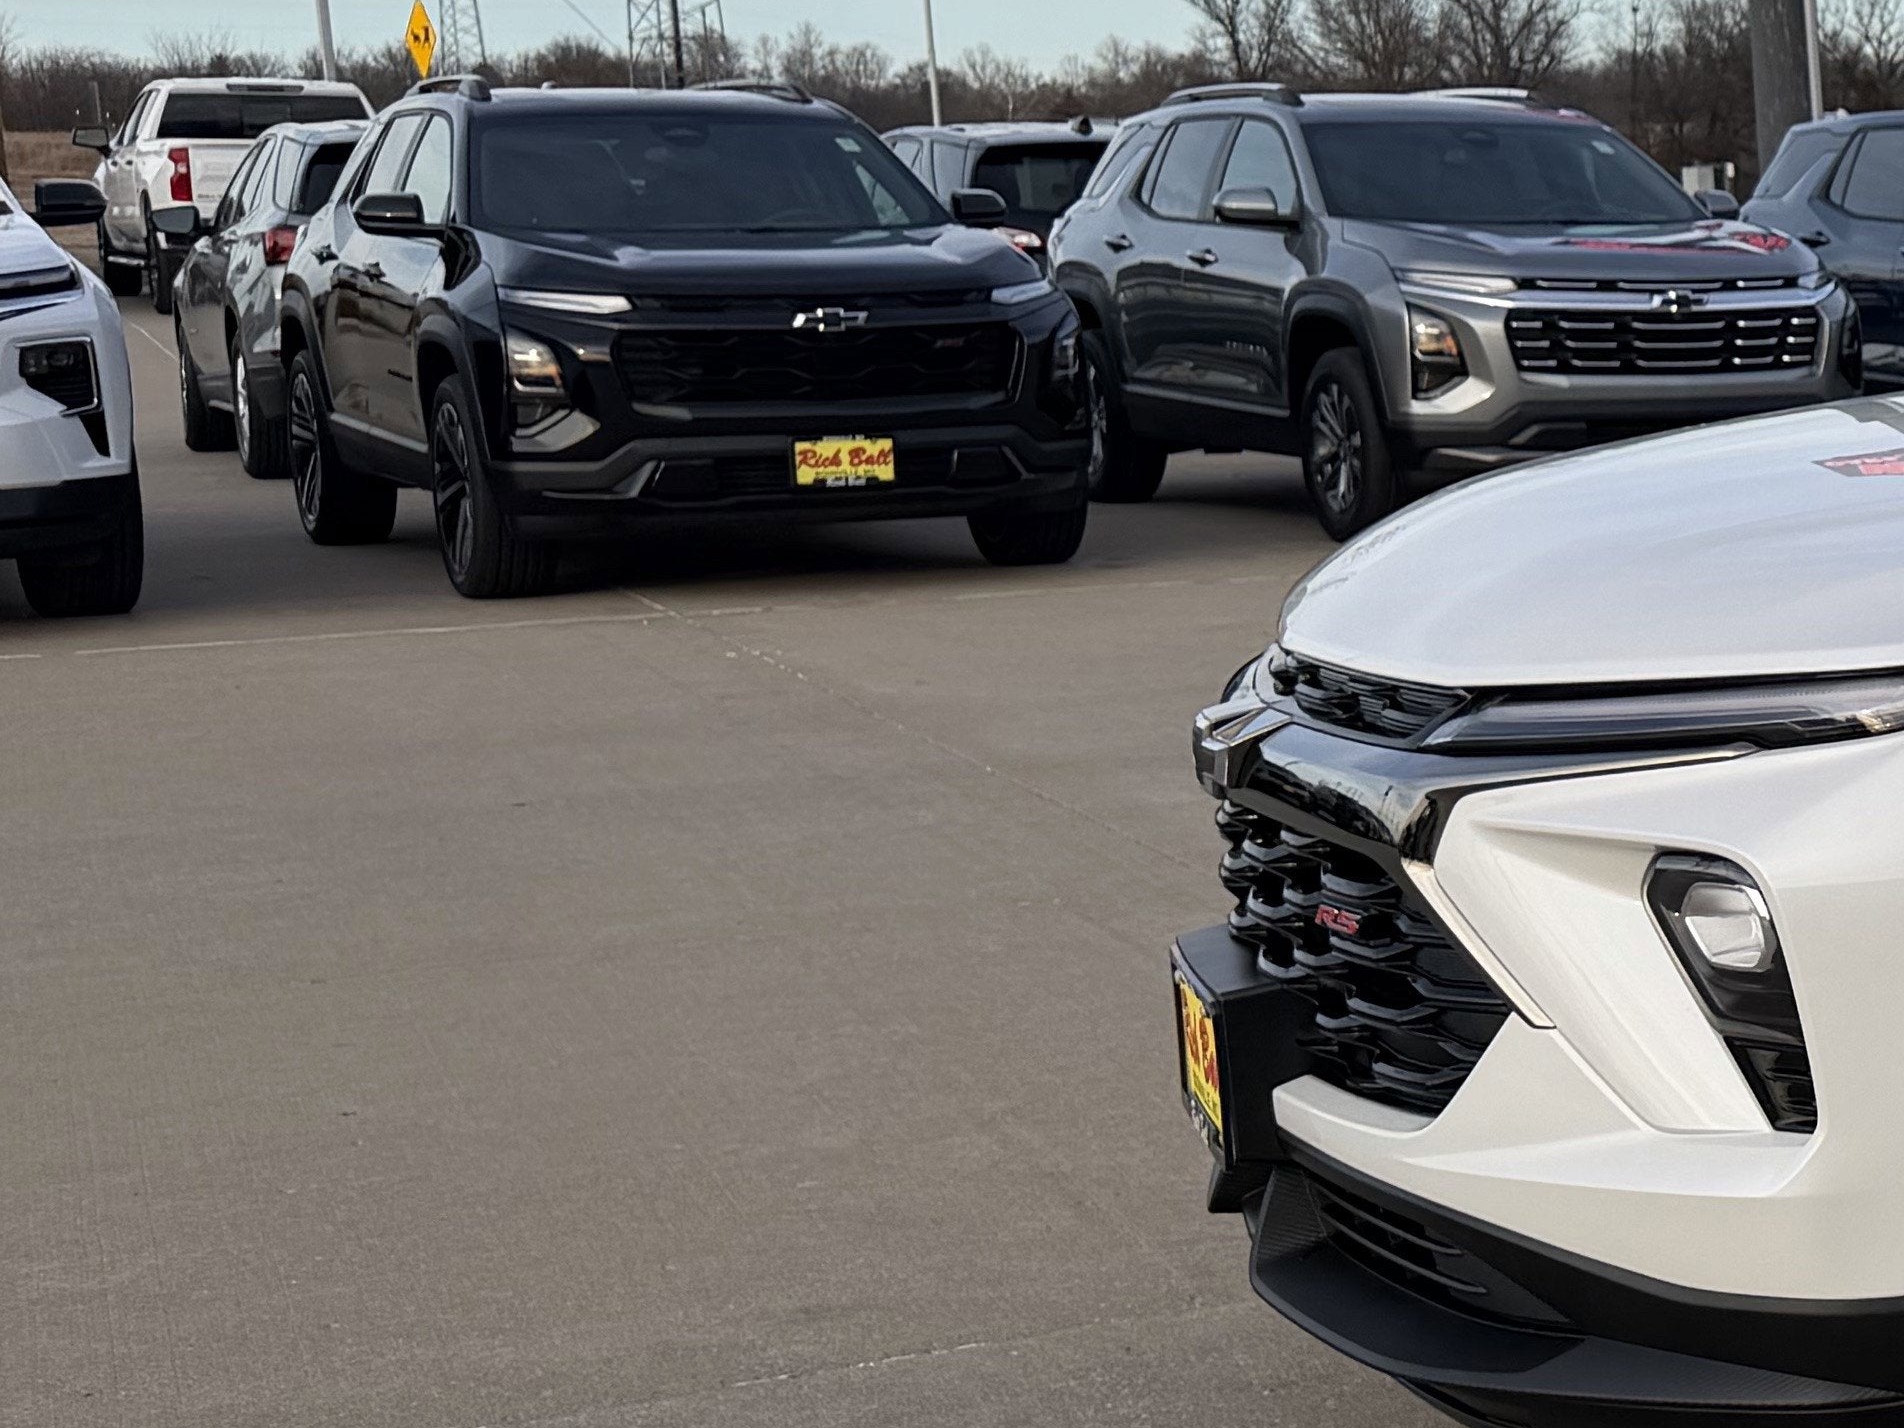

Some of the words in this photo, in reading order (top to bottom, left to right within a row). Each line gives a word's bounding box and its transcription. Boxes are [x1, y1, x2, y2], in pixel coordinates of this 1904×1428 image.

[797, 447, 842, 469] Rick
[848, 446, 893, 467] Ball
[1314, 904, 1362, 935] RS
